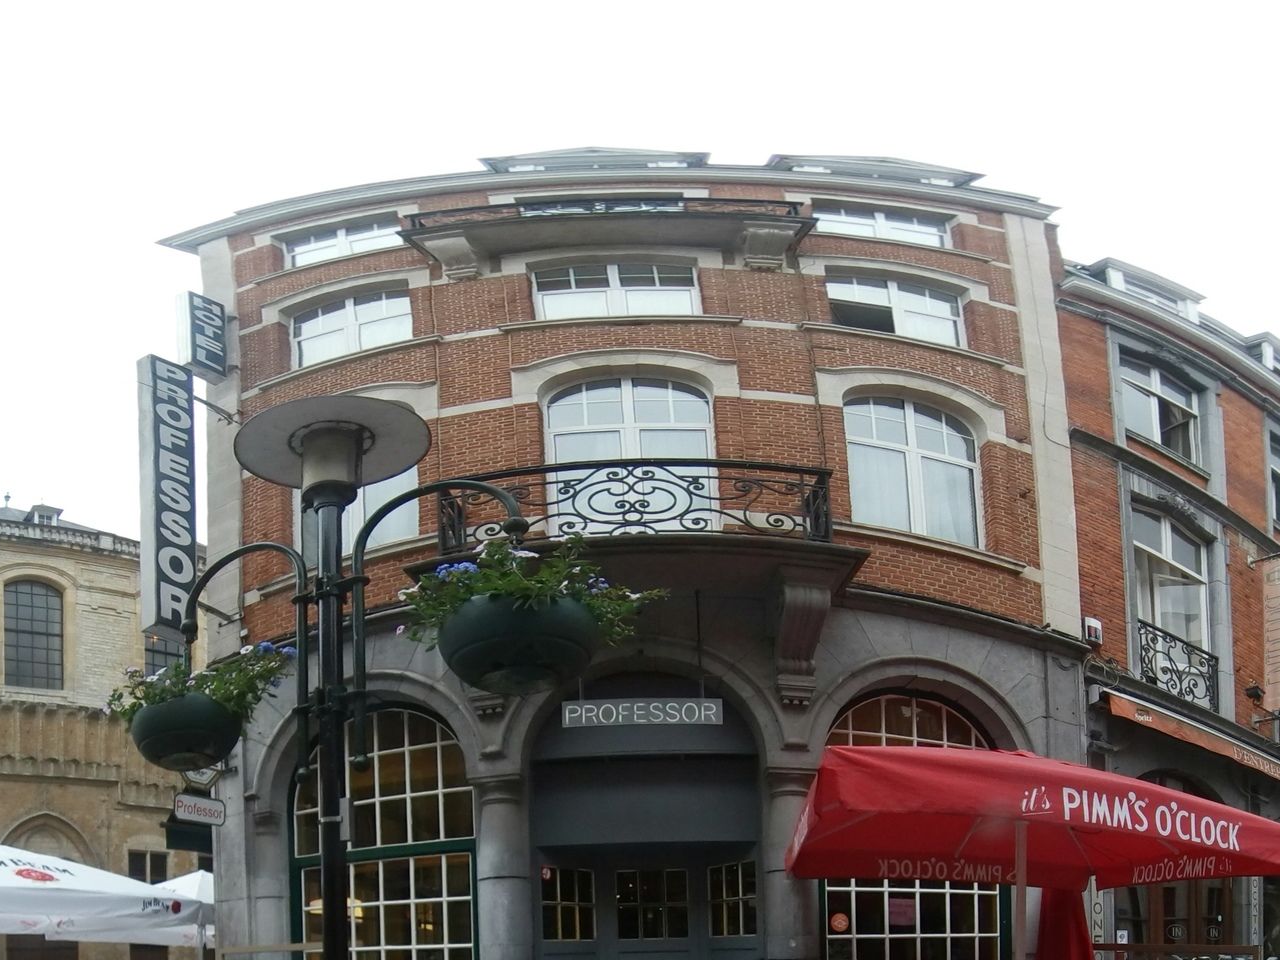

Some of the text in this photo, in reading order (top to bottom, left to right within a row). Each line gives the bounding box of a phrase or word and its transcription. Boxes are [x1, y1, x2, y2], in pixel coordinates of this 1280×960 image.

[193, 295, 224, 370] HOTEL
[155, 359, 195, 632] PROFESSOR
[565, 702, 717, 725] PROFESSOR
[176, 799, 223, 819] Professor
[1021, 786, 1241, 852] it's PIMM'S O'CLOCK
